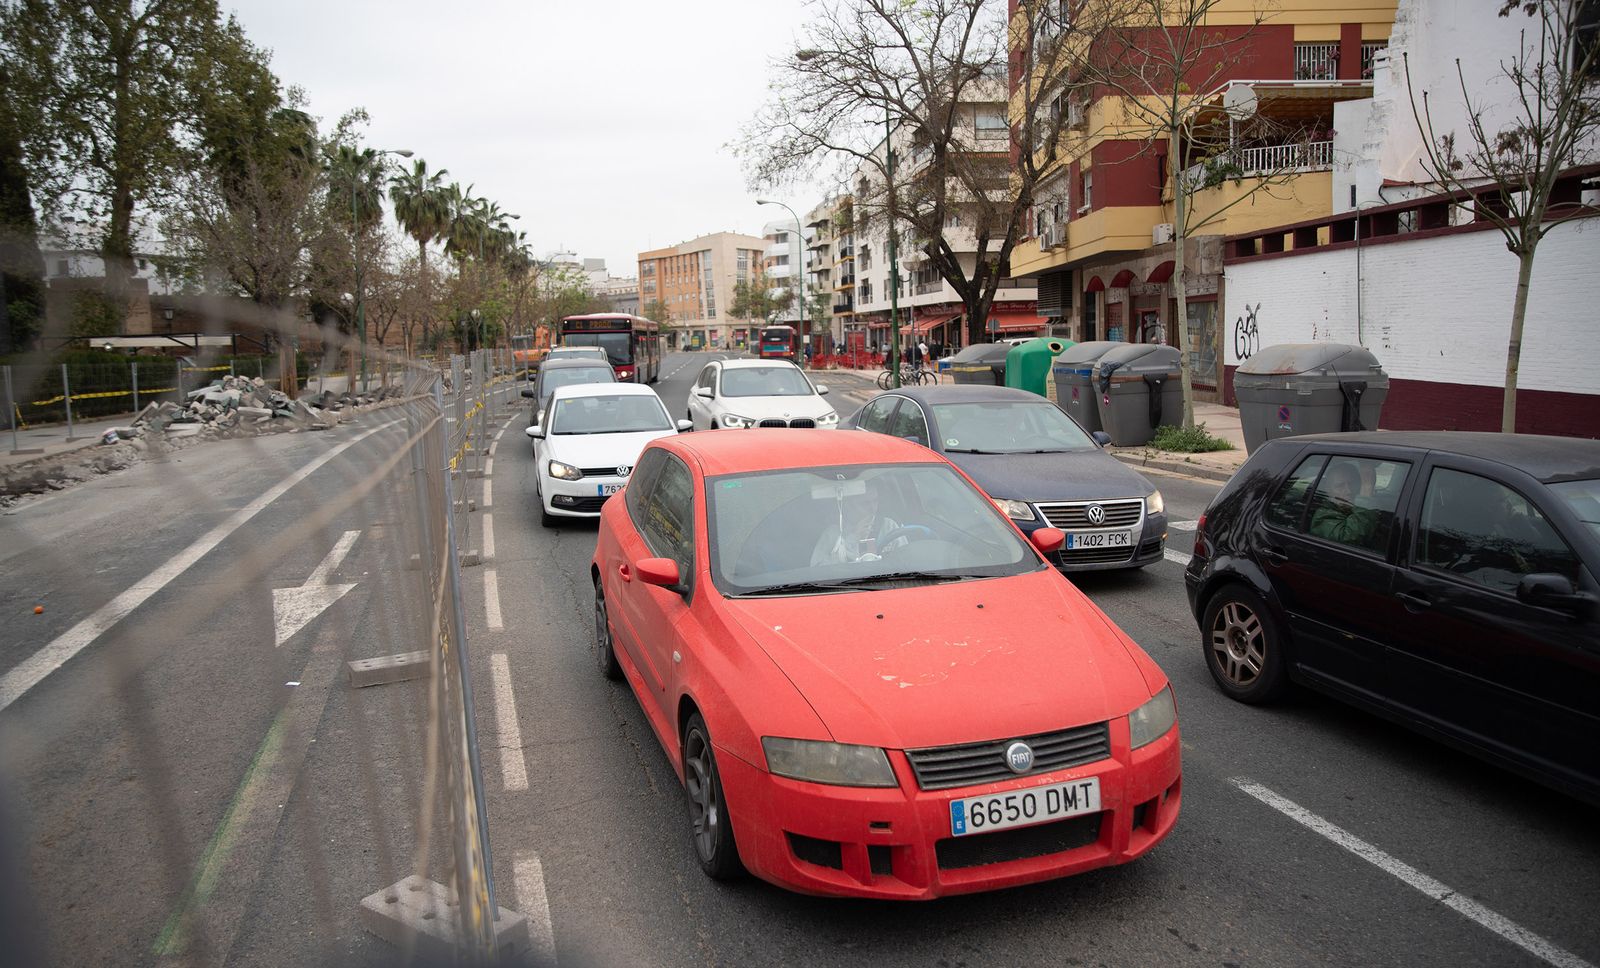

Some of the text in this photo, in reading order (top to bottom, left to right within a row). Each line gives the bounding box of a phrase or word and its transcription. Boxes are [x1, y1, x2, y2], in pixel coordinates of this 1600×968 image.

[605, 484, 626, 494] 762
[1077, 533, 1127, 547] 1402 FCK
[1011, 751, 1030, 765] FIAT
[970, 793, 1037, 828] 6650
[1046, 782, 1093, 815] DMT
